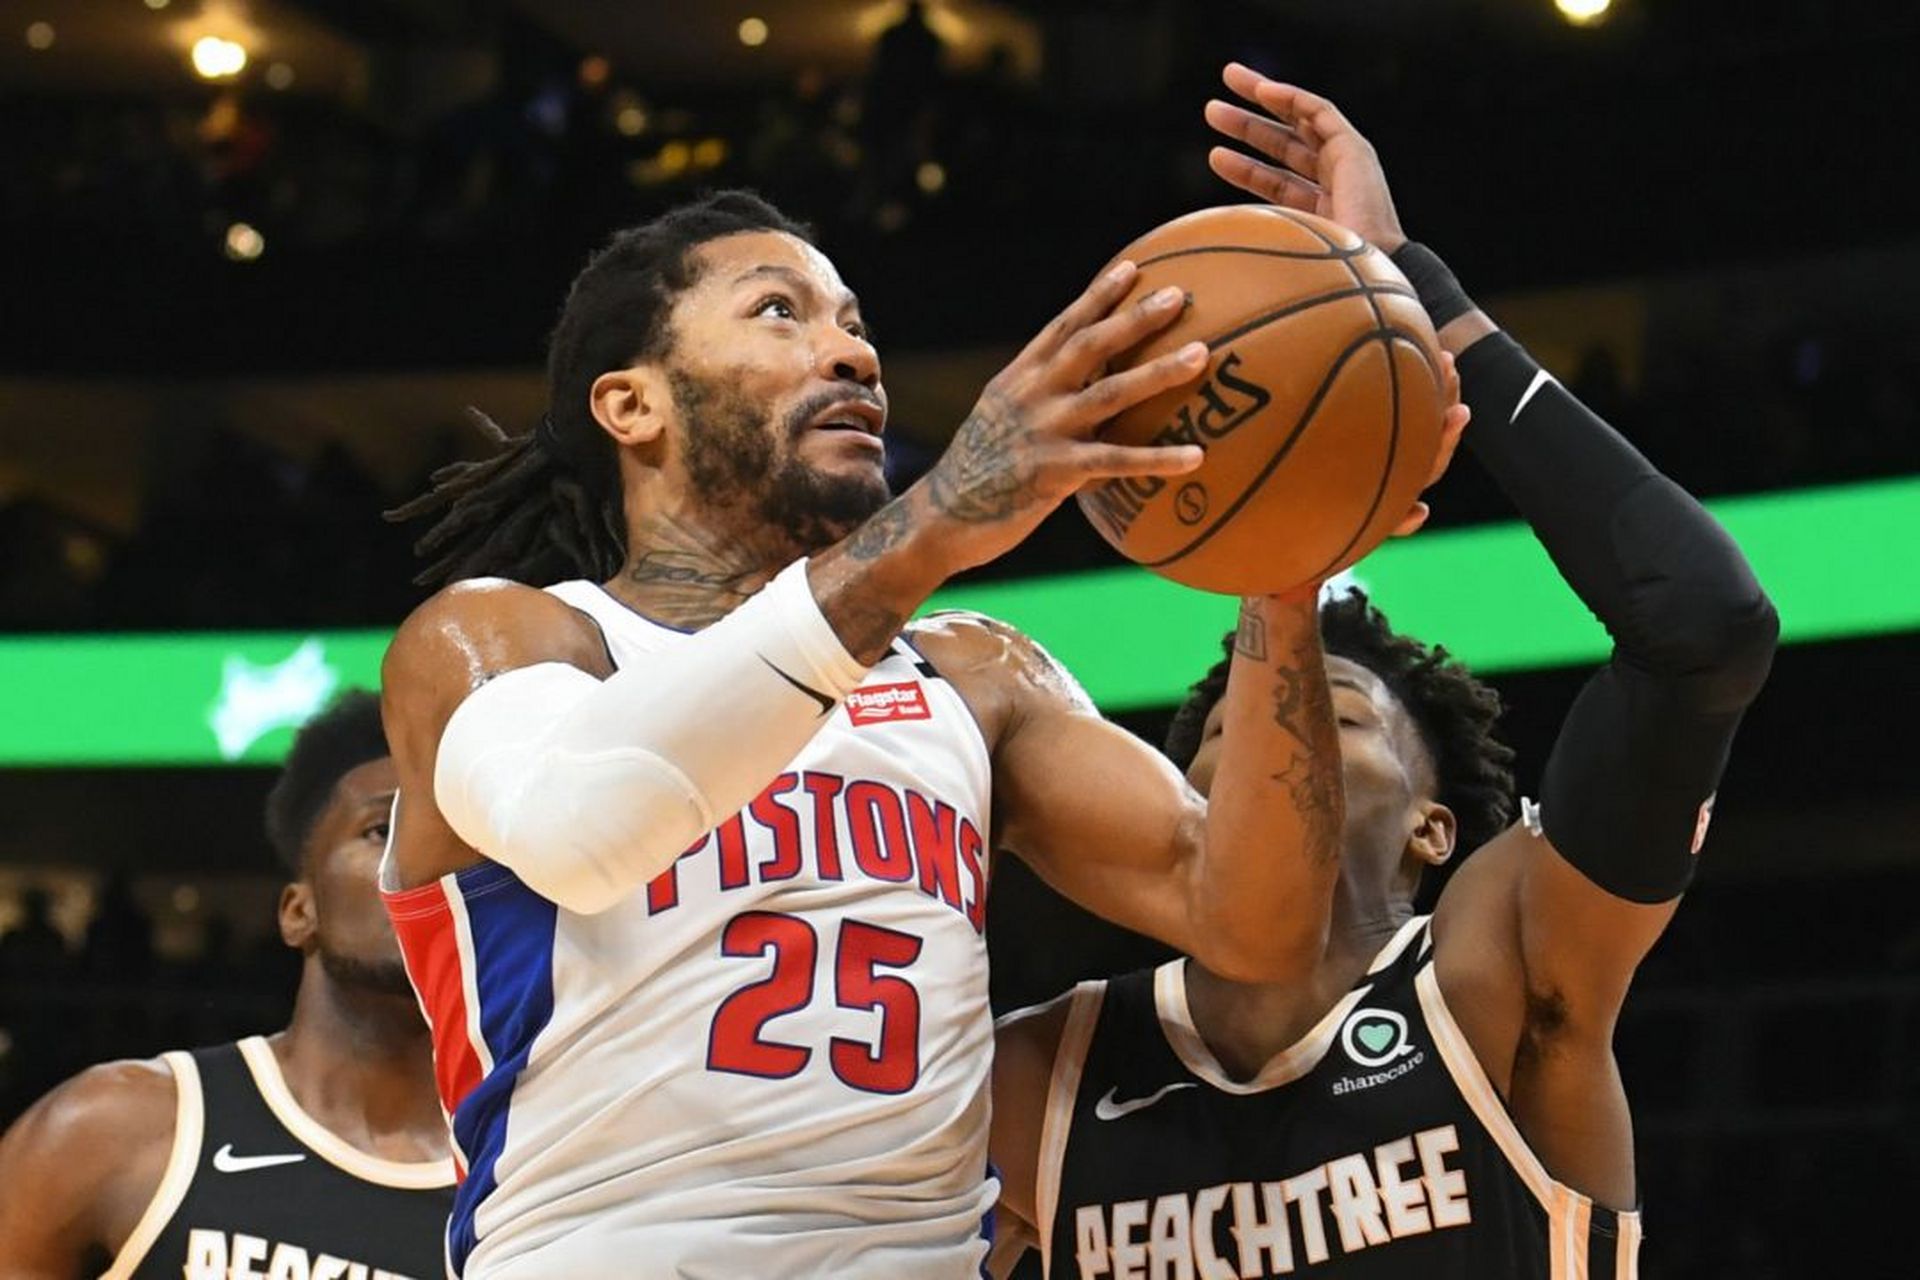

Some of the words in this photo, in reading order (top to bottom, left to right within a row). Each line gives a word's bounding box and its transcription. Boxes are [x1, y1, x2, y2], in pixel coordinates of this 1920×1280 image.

[847, 687, 918, 708] Flagstar
[706, 910, 923, 1095] 25
[1332, 1052, 1424, 1095] sharecare
[1075, 1124, 1471, 1280] PEACHTREE
